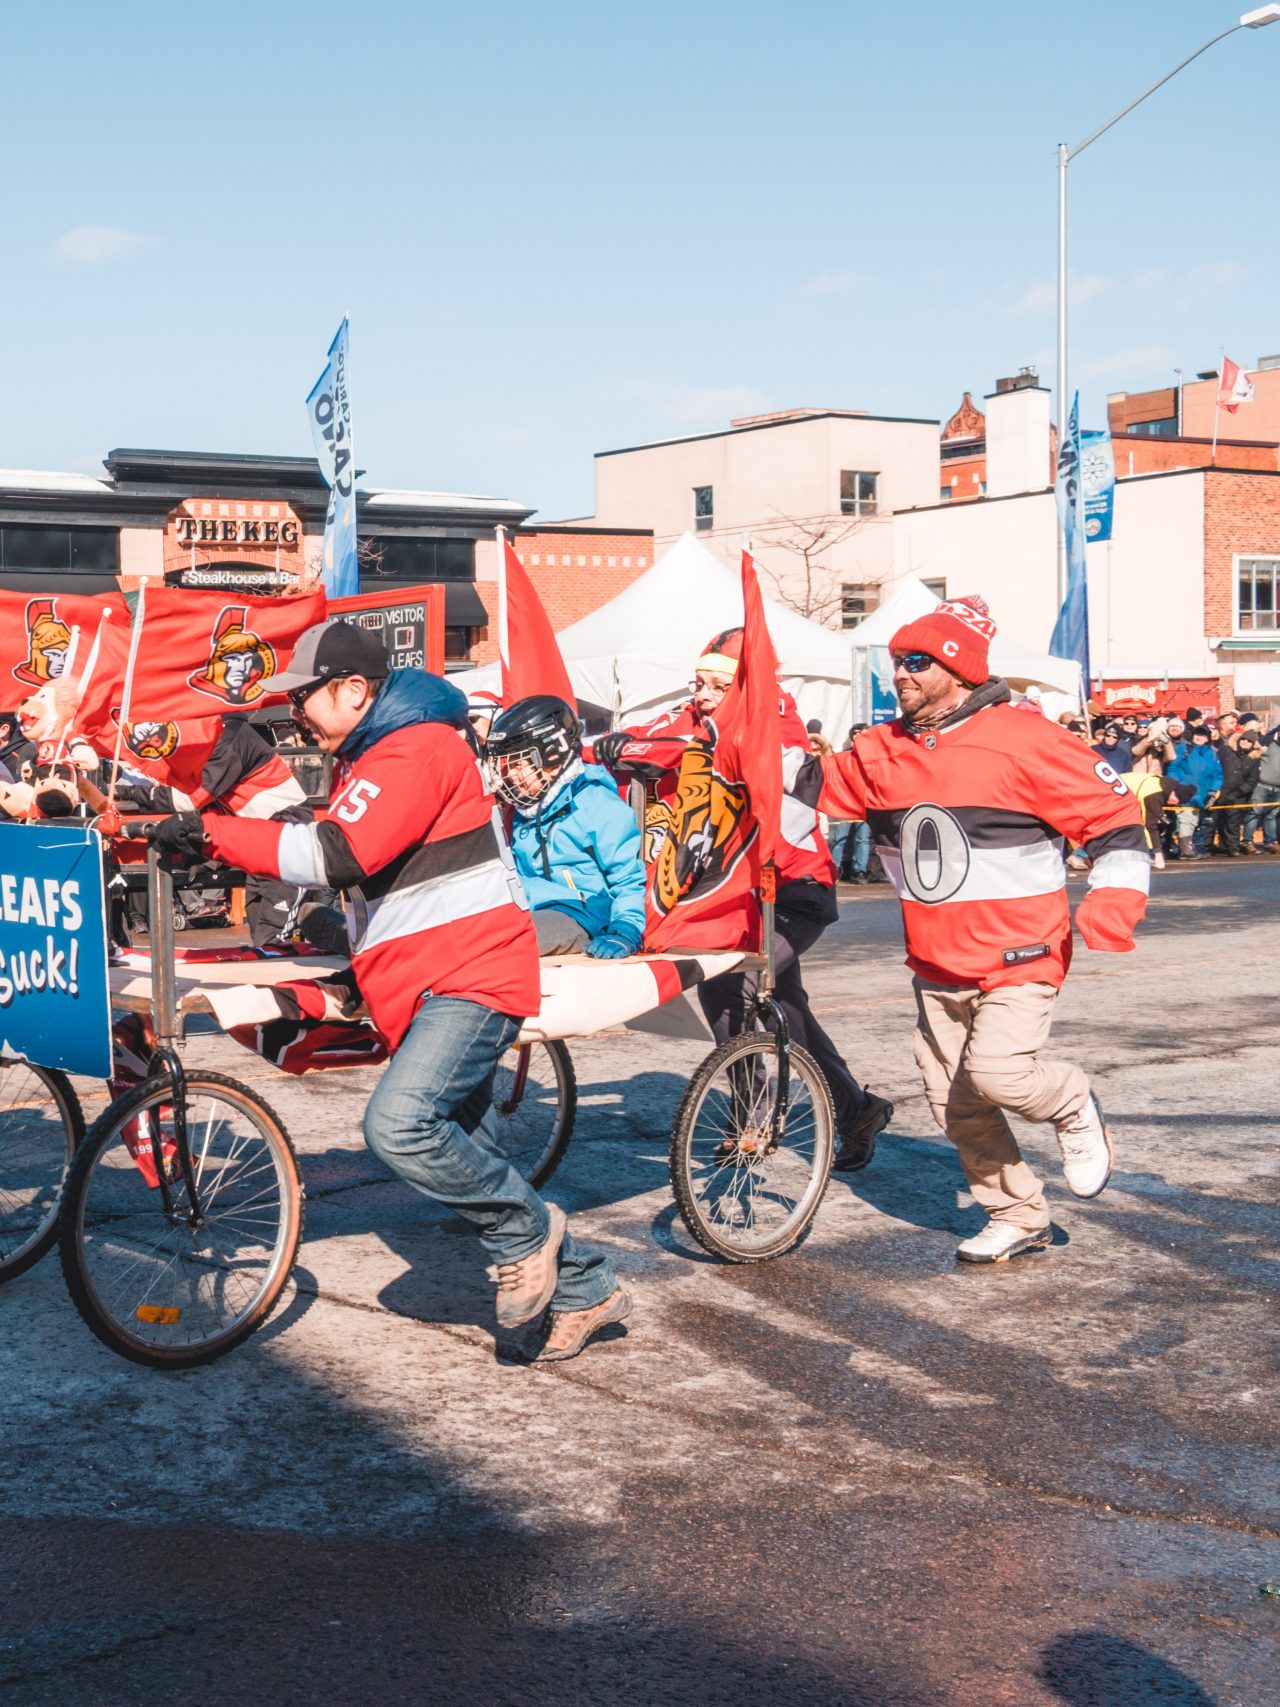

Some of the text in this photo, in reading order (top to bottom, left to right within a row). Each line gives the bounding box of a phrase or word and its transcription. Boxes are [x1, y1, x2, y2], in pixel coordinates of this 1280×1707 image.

[179, 519, 299, 543] THE KEG
[188, 571, 300, 585] Steakhouse & Bar
[386, 606, 425, 625] VISITOR
[942, 640, 959, 658] C
[391, 650, 424, 669] LEAFS
[1093, 760, 1129, 796] 9
